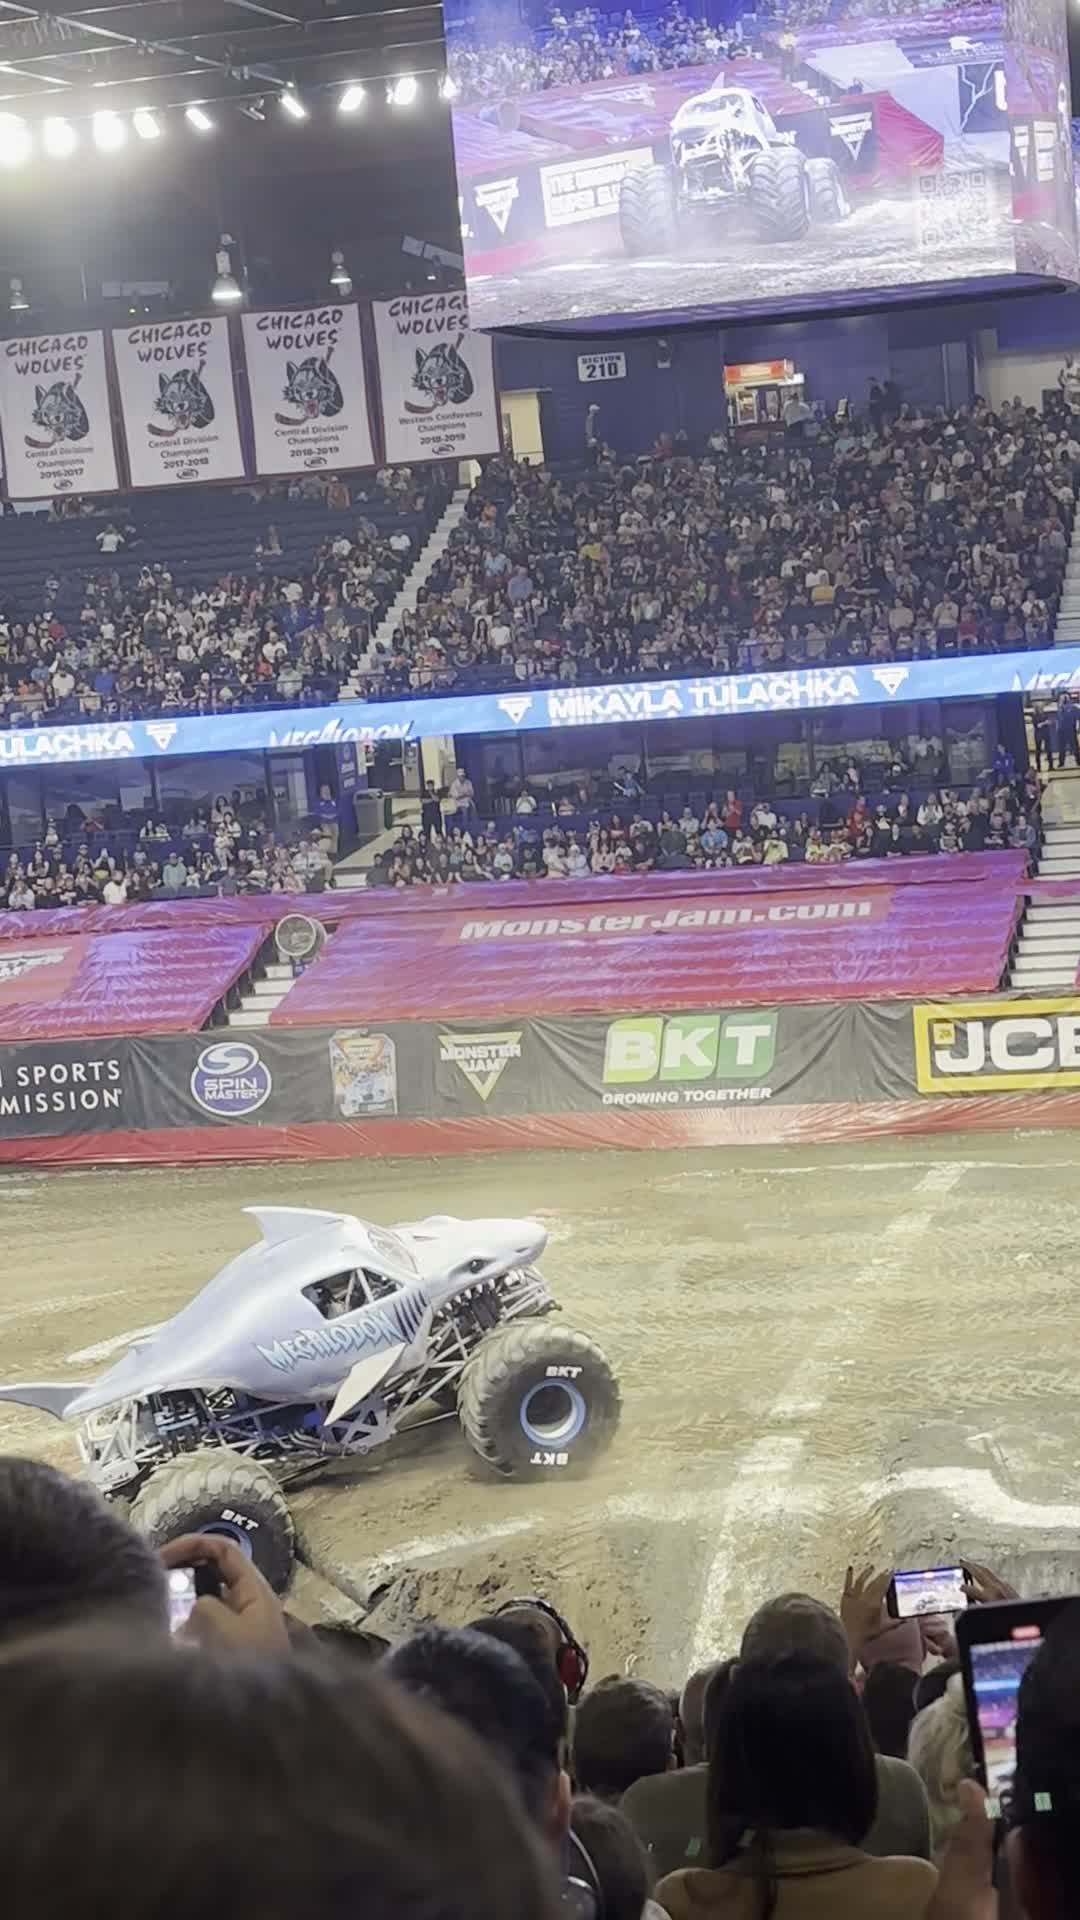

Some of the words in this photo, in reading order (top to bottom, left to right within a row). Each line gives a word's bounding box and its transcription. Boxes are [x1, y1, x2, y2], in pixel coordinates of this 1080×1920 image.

[256, 309, 343, 331] CHICAGO
[397, 314, 469, 335] WOLVES
[128, 322, 212, 344] CHICAGO
[266, 329, 338, 350] WOLVES
[6, 336, 88, 357] CHICAGO
[138, 341, 208, 363] WOLVES
[15, 355, 84, 375] WOLVES
[586, 362, 618, 378] 210
[274, 427, 309, 437] Central
[312, 424, 349, 434] Division
[418, 422, 466, 433] Champions
[148, 439, 180, 449] Central
[183, 434, 219, 444] Division
[287, 434, 339, 445] Champions
[25, 449, 57, 459] Central
[37, 458, 85, 469] Champions
[549, 688, 684, 719] MIKAYLA
[689, 674, 859, 707] TULACHKA
[460, 901, 872, 939] MonsterJam.com
[440, 1044, 521, 1061] MONSTER
[607, 1024, 772, 1069] BKT
[17, 1060, 120, 1087] SPORTS
[464, 1058, 500, 1072] JAM
[203, 1077, 257, 1090] SPIN
[204, 1089, 259, 1101] MASTER
[602, 1091, 679, 1105] GROWING
[684, 1087, 773, 1103] TOGETHER
[255, 1310, 403, 1373] MEGALODON
[546, 1365, 583, 1378] BKT
[530, 1451, 569, 1466] BKT
[220, 1509, 259, 1530] BKT
